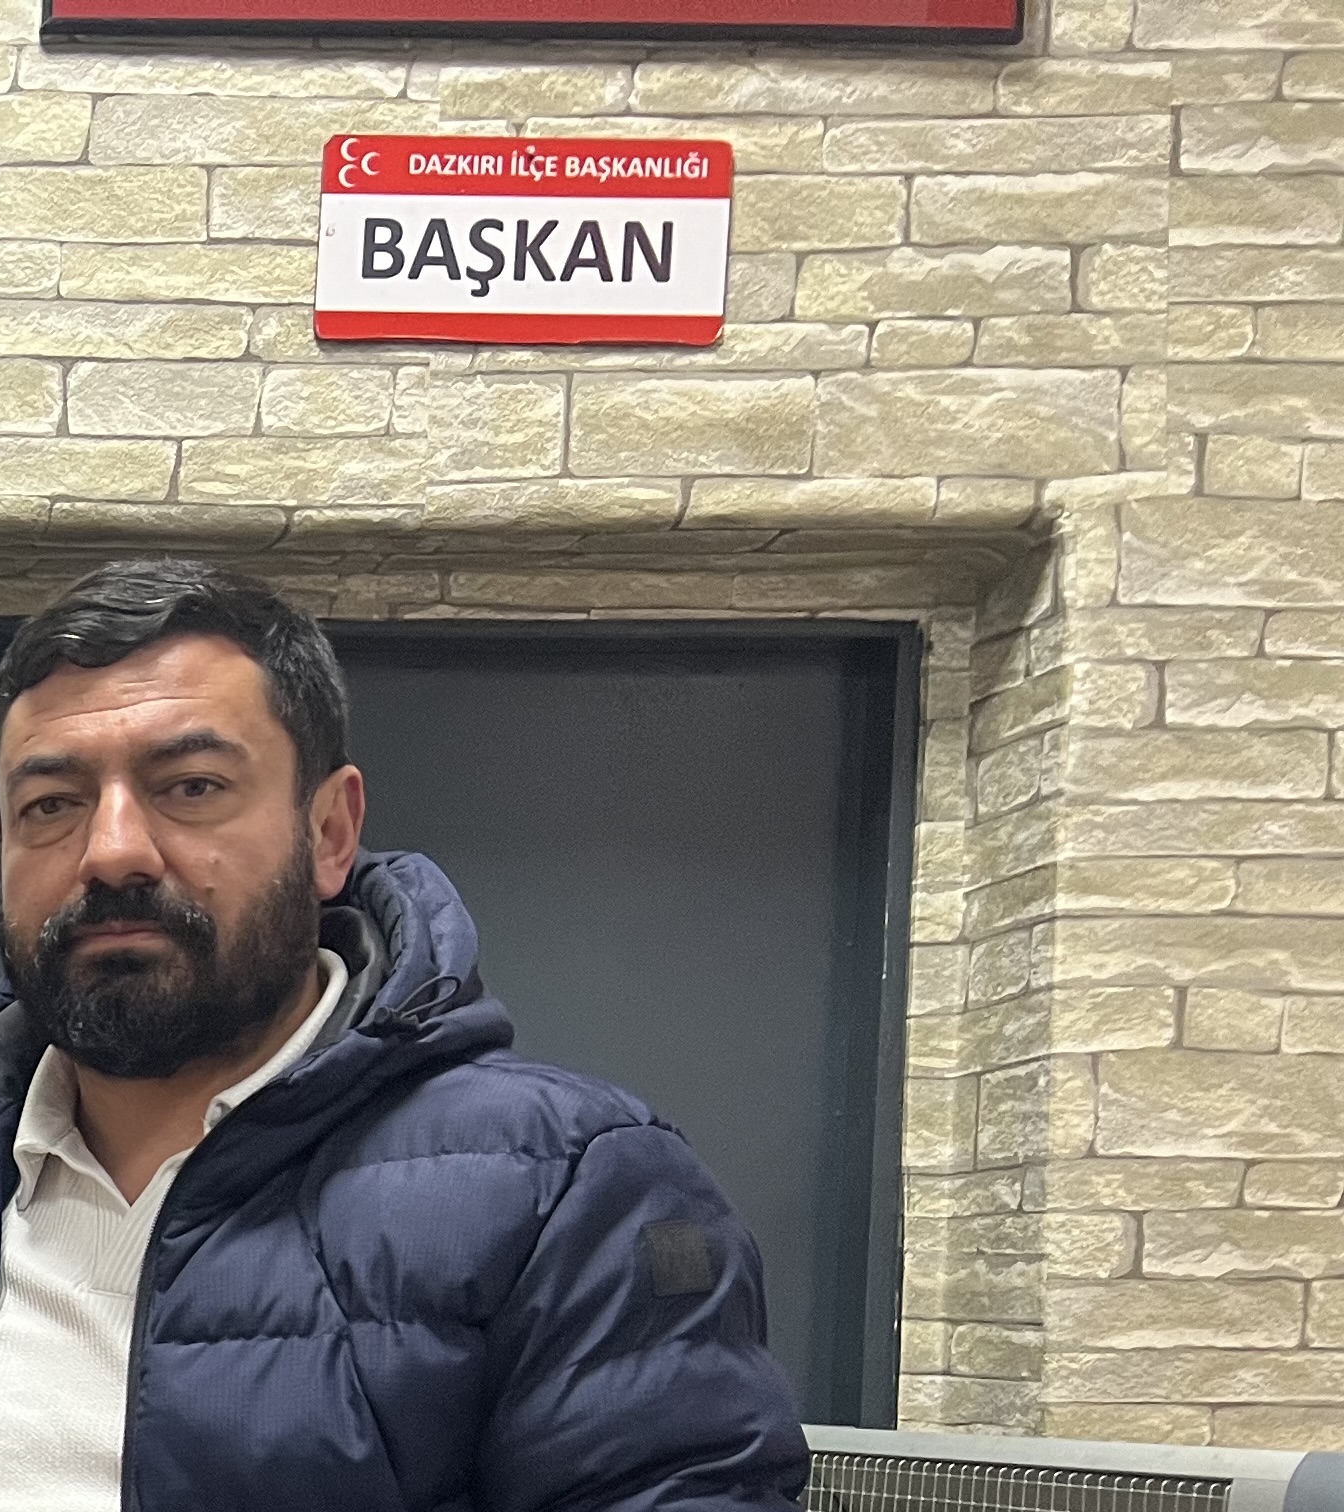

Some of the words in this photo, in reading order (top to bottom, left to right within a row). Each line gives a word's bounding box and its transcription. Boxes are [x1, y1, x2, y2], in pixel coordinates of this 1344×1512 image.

[408, 153, 503, 177] DAZKIRI
[510, 148, 558, 182] İLÇE
[565, 150, 710, 183] BAŞKANLIĞI
[360, 216, 675, 298] BAŞKAN
